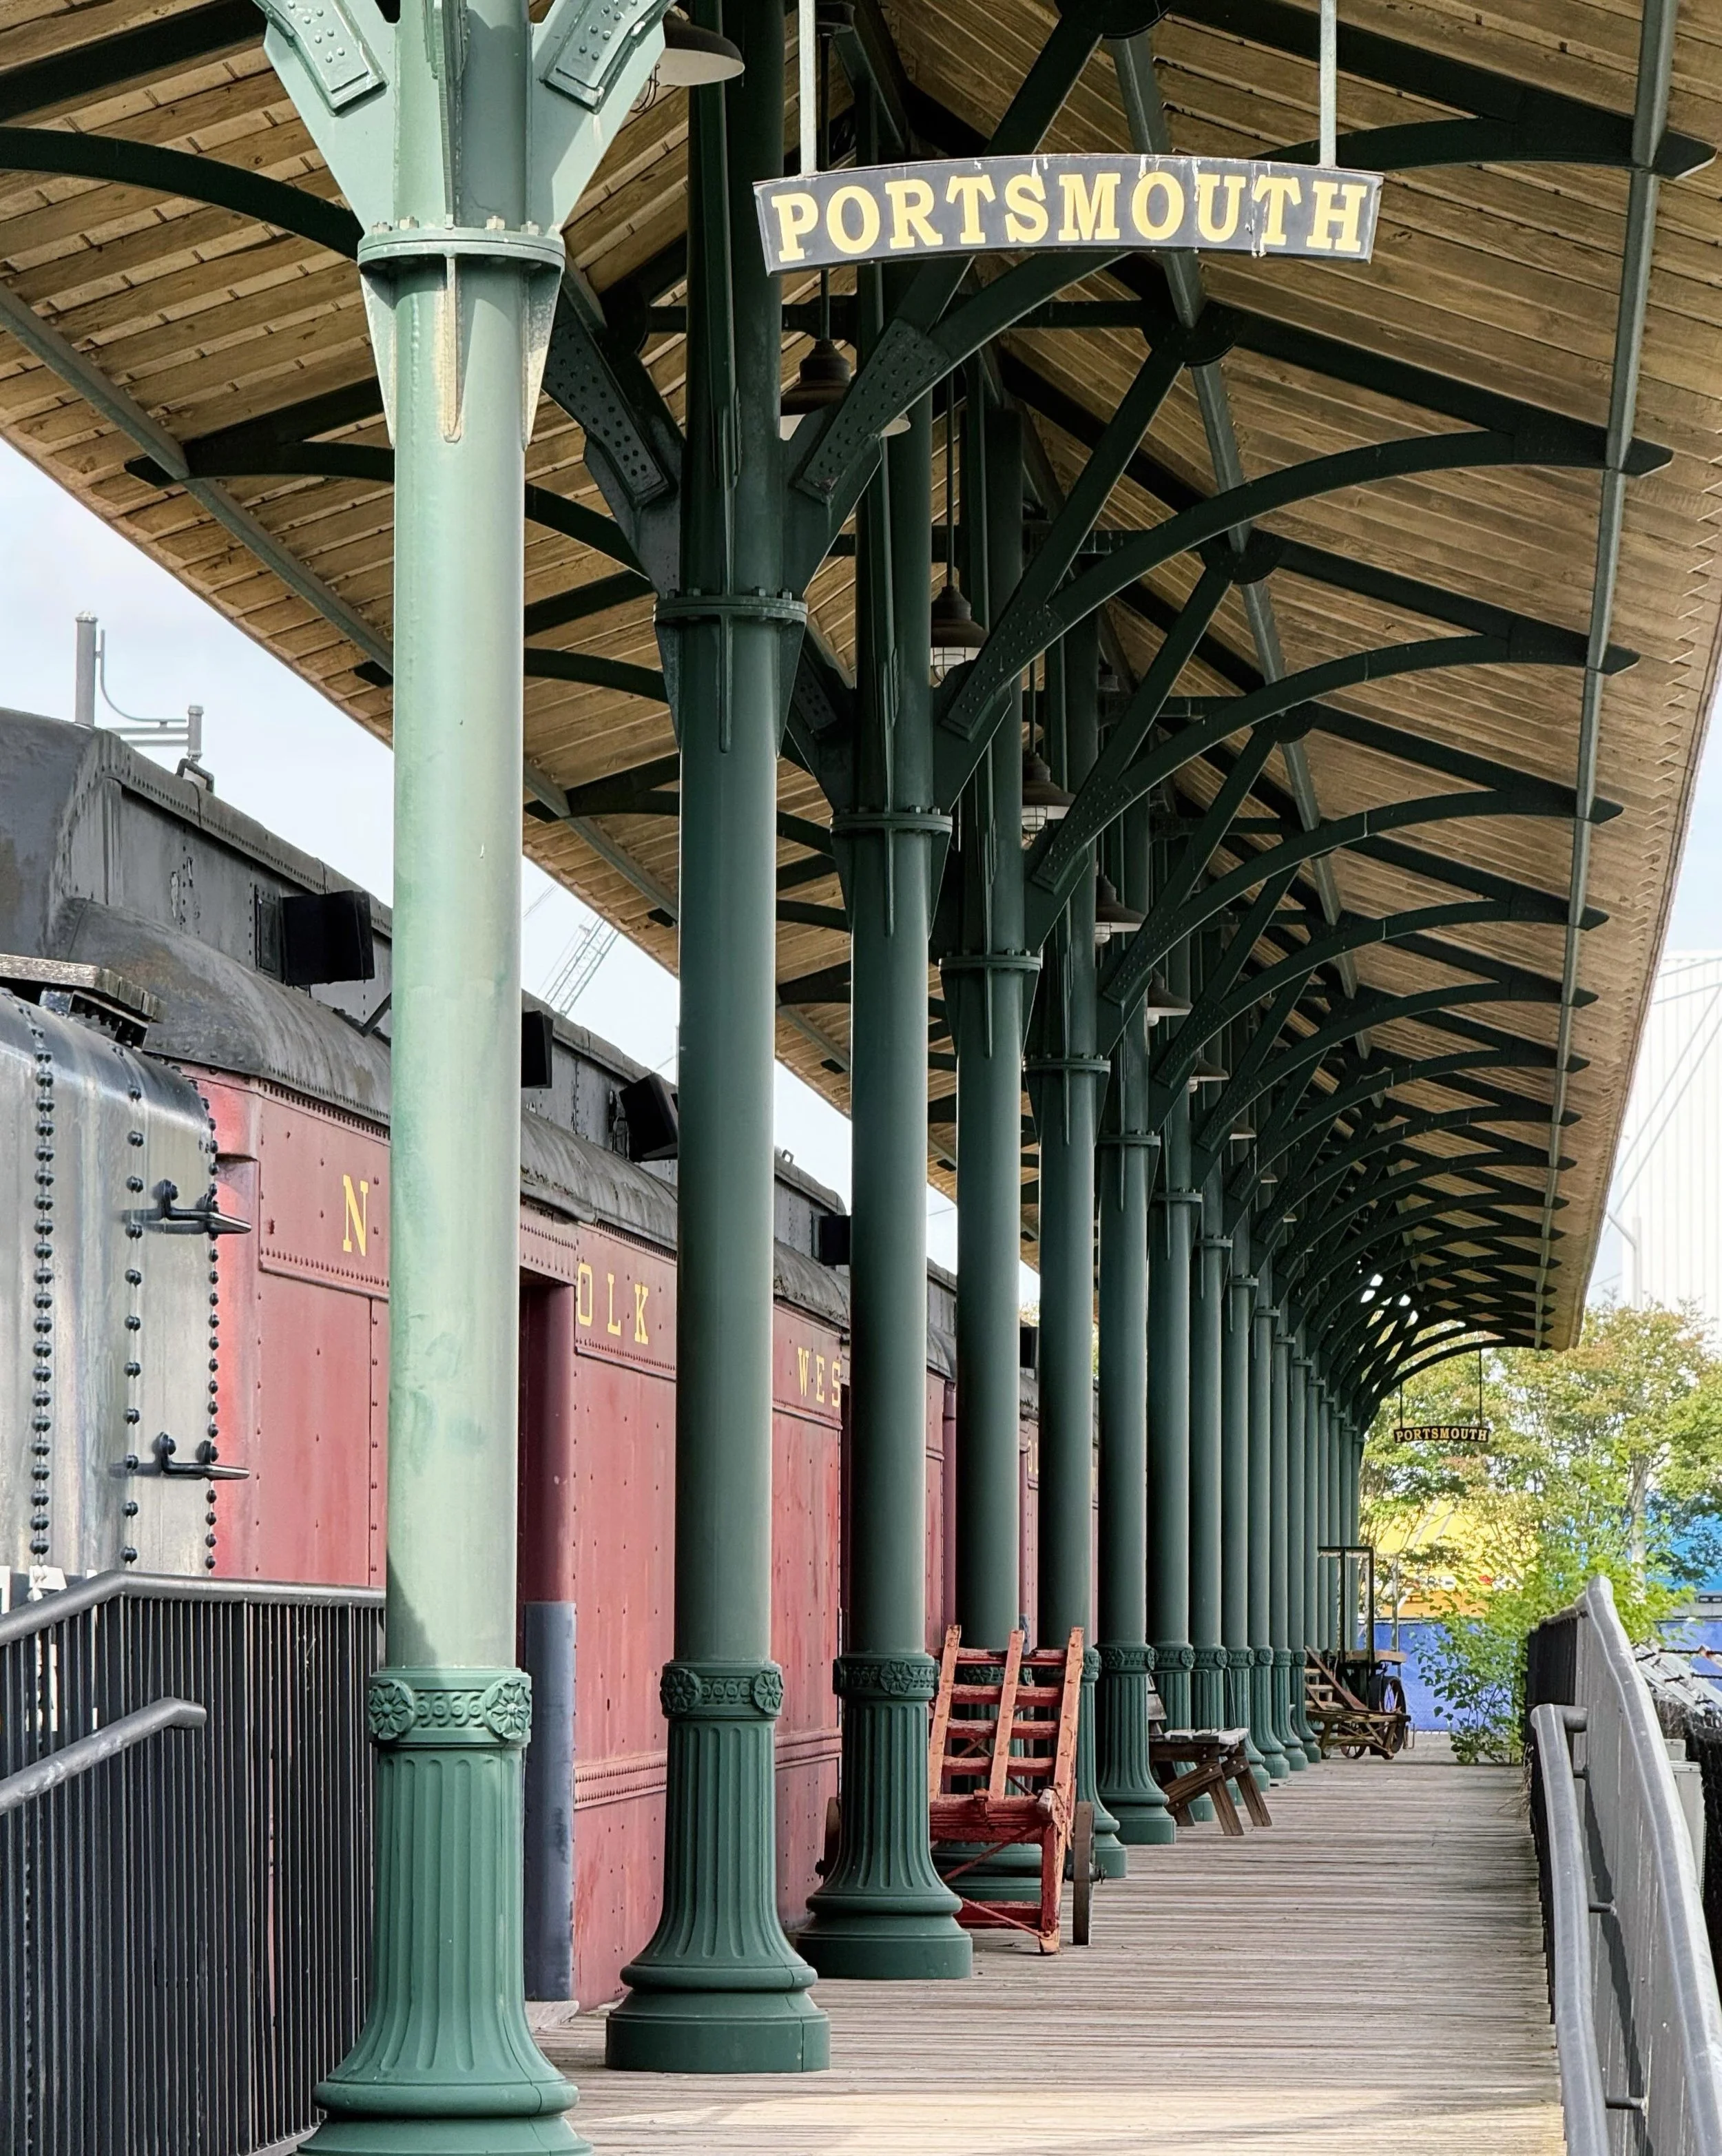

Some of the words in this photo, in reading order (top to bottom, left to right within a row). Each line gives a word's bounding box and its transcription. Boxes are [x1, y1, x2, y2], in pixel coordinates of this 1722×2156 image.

[771, 172, 1368, 262] PORTSMOUTH
[798, 1347, 841, 1408] WES
[1396, 1427, 1488, 1442] PORTSMOUTH
